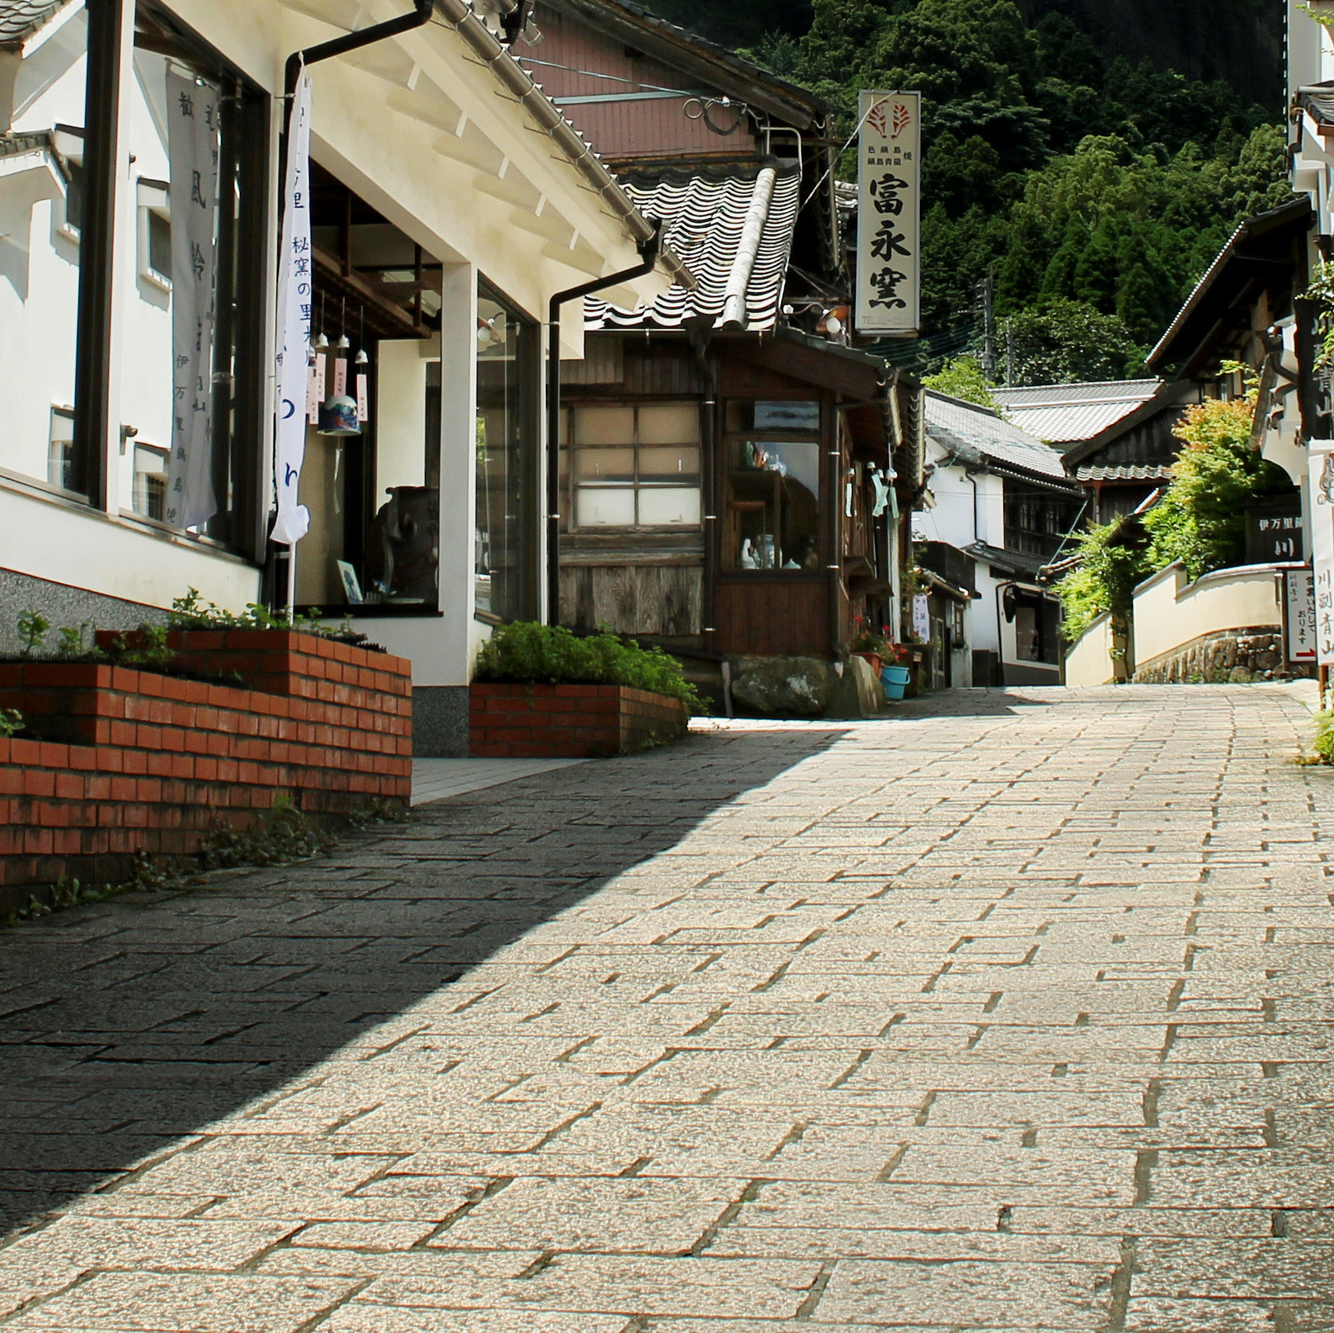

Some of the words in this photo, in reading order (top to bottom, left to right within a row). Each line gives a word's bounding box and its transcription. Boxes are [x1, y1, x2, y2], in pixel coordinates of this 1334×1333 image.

[869, 173, 912, 310] 富永窯
[1311, 317, 1334, 418] 川青山
[1297, 609, 1307, 645] おります
